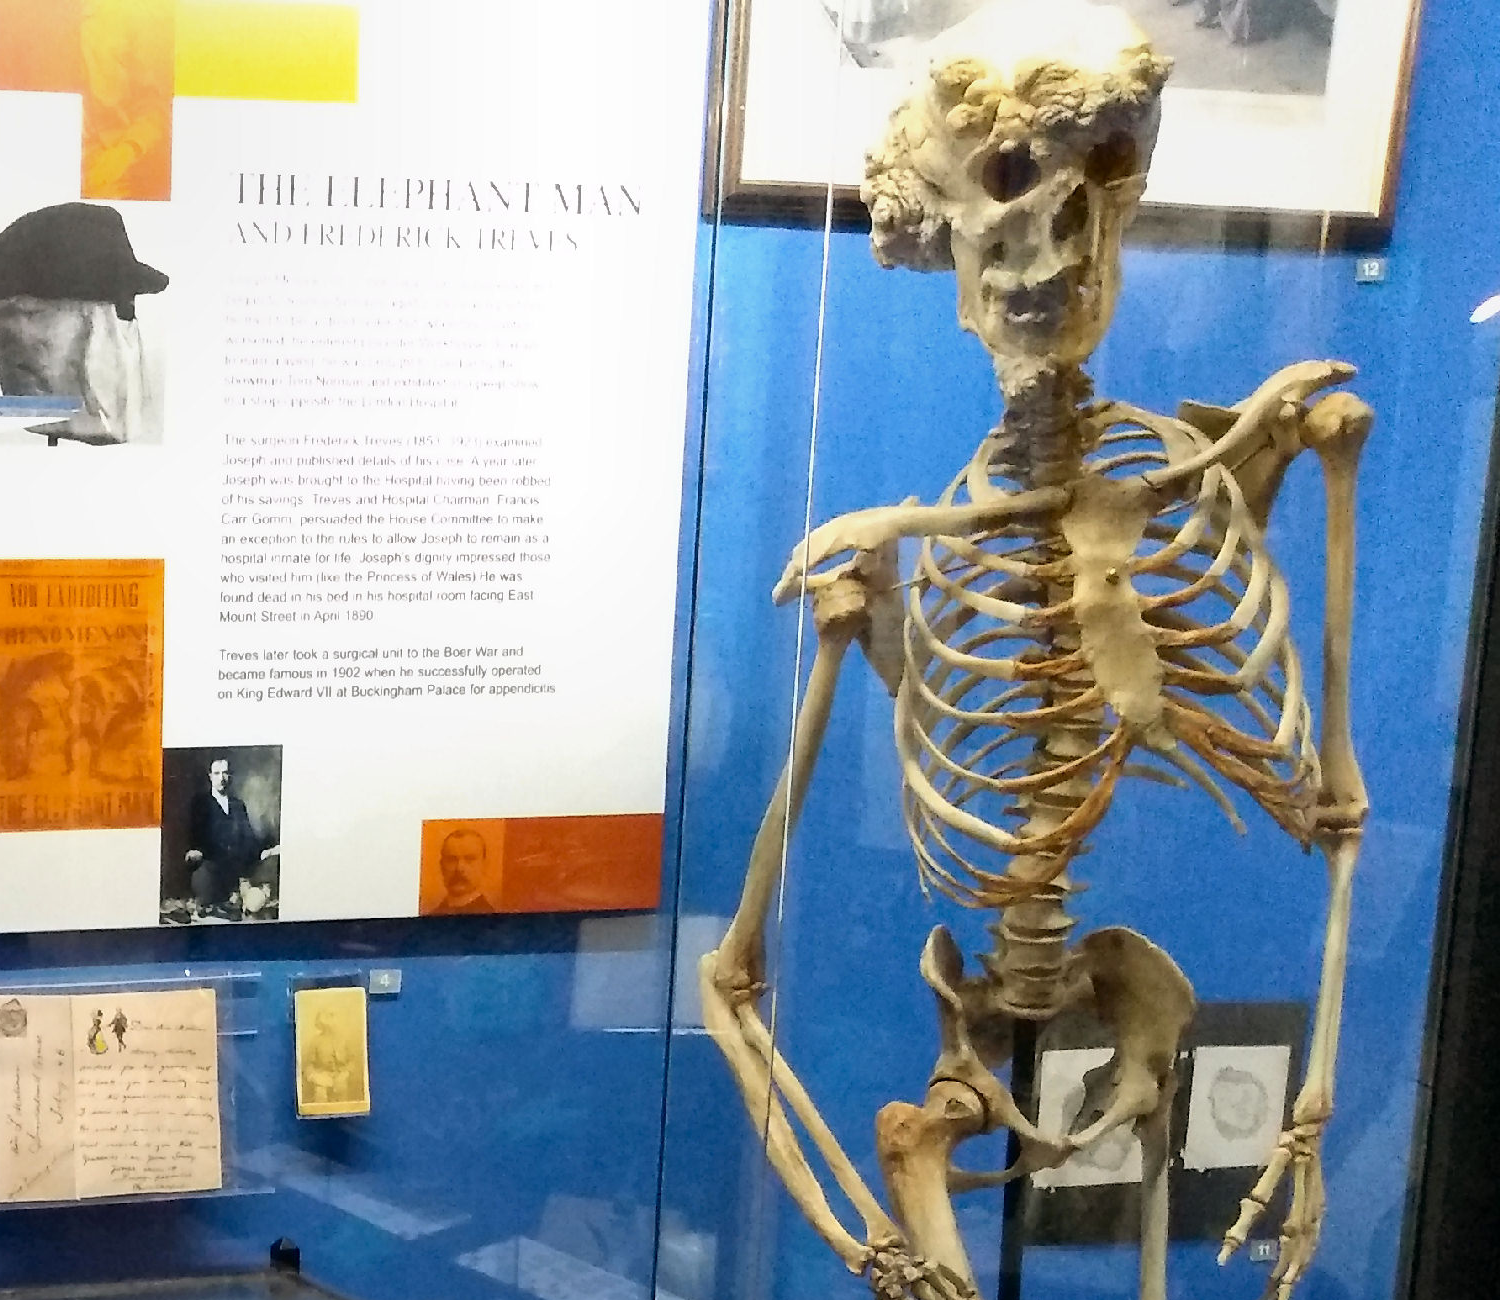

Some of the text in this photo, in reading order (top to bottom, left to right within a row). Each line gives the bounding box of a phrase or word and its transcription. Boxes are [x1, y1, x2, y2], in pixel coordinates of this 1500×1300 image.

[229, 172, 642, 217] THE ELEPHANT MAN
[230, 221, 292, 245] AND
[303, 222, 461, 250] FREDERICK
[1363, 263, 1379, 276] 12
[223, 454, 266, 469] Joseph
[269, 456, 293, 467] and
[296, 455, 355, 467] published
[358, 455, 397, 466] details
[400, 455, 412, 466] of
[223, 474, 551, 488] Joseph was brought to the Hospital having been robbed
[221, 493, 234, 505] of
[237, 493, 255, 505] his
[312, 493, 352, 505] Treves
[355, 495, 378, 505] and
[381, 493, 429, 508] Hospital
[497, 493, 540, 505] Francis
[221, 512, 248, 525] Carr
[300, 513, 363, 528] persuaded
[366, 513, 385, 525] the
[389, 513, 427, 525] House
[430, 513, 494, 524] Committee
[497, 514, 509, 524] to
[512, 514, 544, 524] make
[221, 532, 549, 545] an exception to the rules to allow Joseph to remain as a
[220, 552, 267, 566] hospital
[270, 553, 311, 564] inmate
[315, 551, 331, 564] for
[359, 551, 411, 566] Joseph's
[414, 552, 452, 566] dignity
[456, 551, 516, 565] impressed
[519, 551, 551, 563] those
[220, 571, 245, 584] who
[248, 571, 287, 584] visited
[290, 571, 313, 583] him
[316, 571, 341, 584] (like
[344, 571, 363, 583] the
[367, 570, 418, 583] Princess
[421, 570, 433, 582] of
[479, 570, 496, 582] He
[499, 573, 523, 582] was
[220, 588, 534, 603] found dead in his bed in his hospital room facing East
[219, 610, 257, 623] Mount
[260, 610, 297, 623] Street
[300, 612, 311, 622] in
[313, 610, 340, 624] April
[219, 645, 524, 662] Treves later took a surgical unit to the Boer War and
[218, 664, 542, 681] became famous in 1902 when he successfully operated
[217, 690, 233, 700] on
[236, 687, 264, 703] King
[267, 685, 313, 699] Edward
[316, 685, 332, 698] VII
[336, 686, 348, 698] at
[351, 685, 423, 700] Buckingham
[427, 684, 466, 696] Palace
[470, 683, 486, 696] for
[380, 974, 390, 987] 4
[1258, 1245, 1270, 1255] 11
